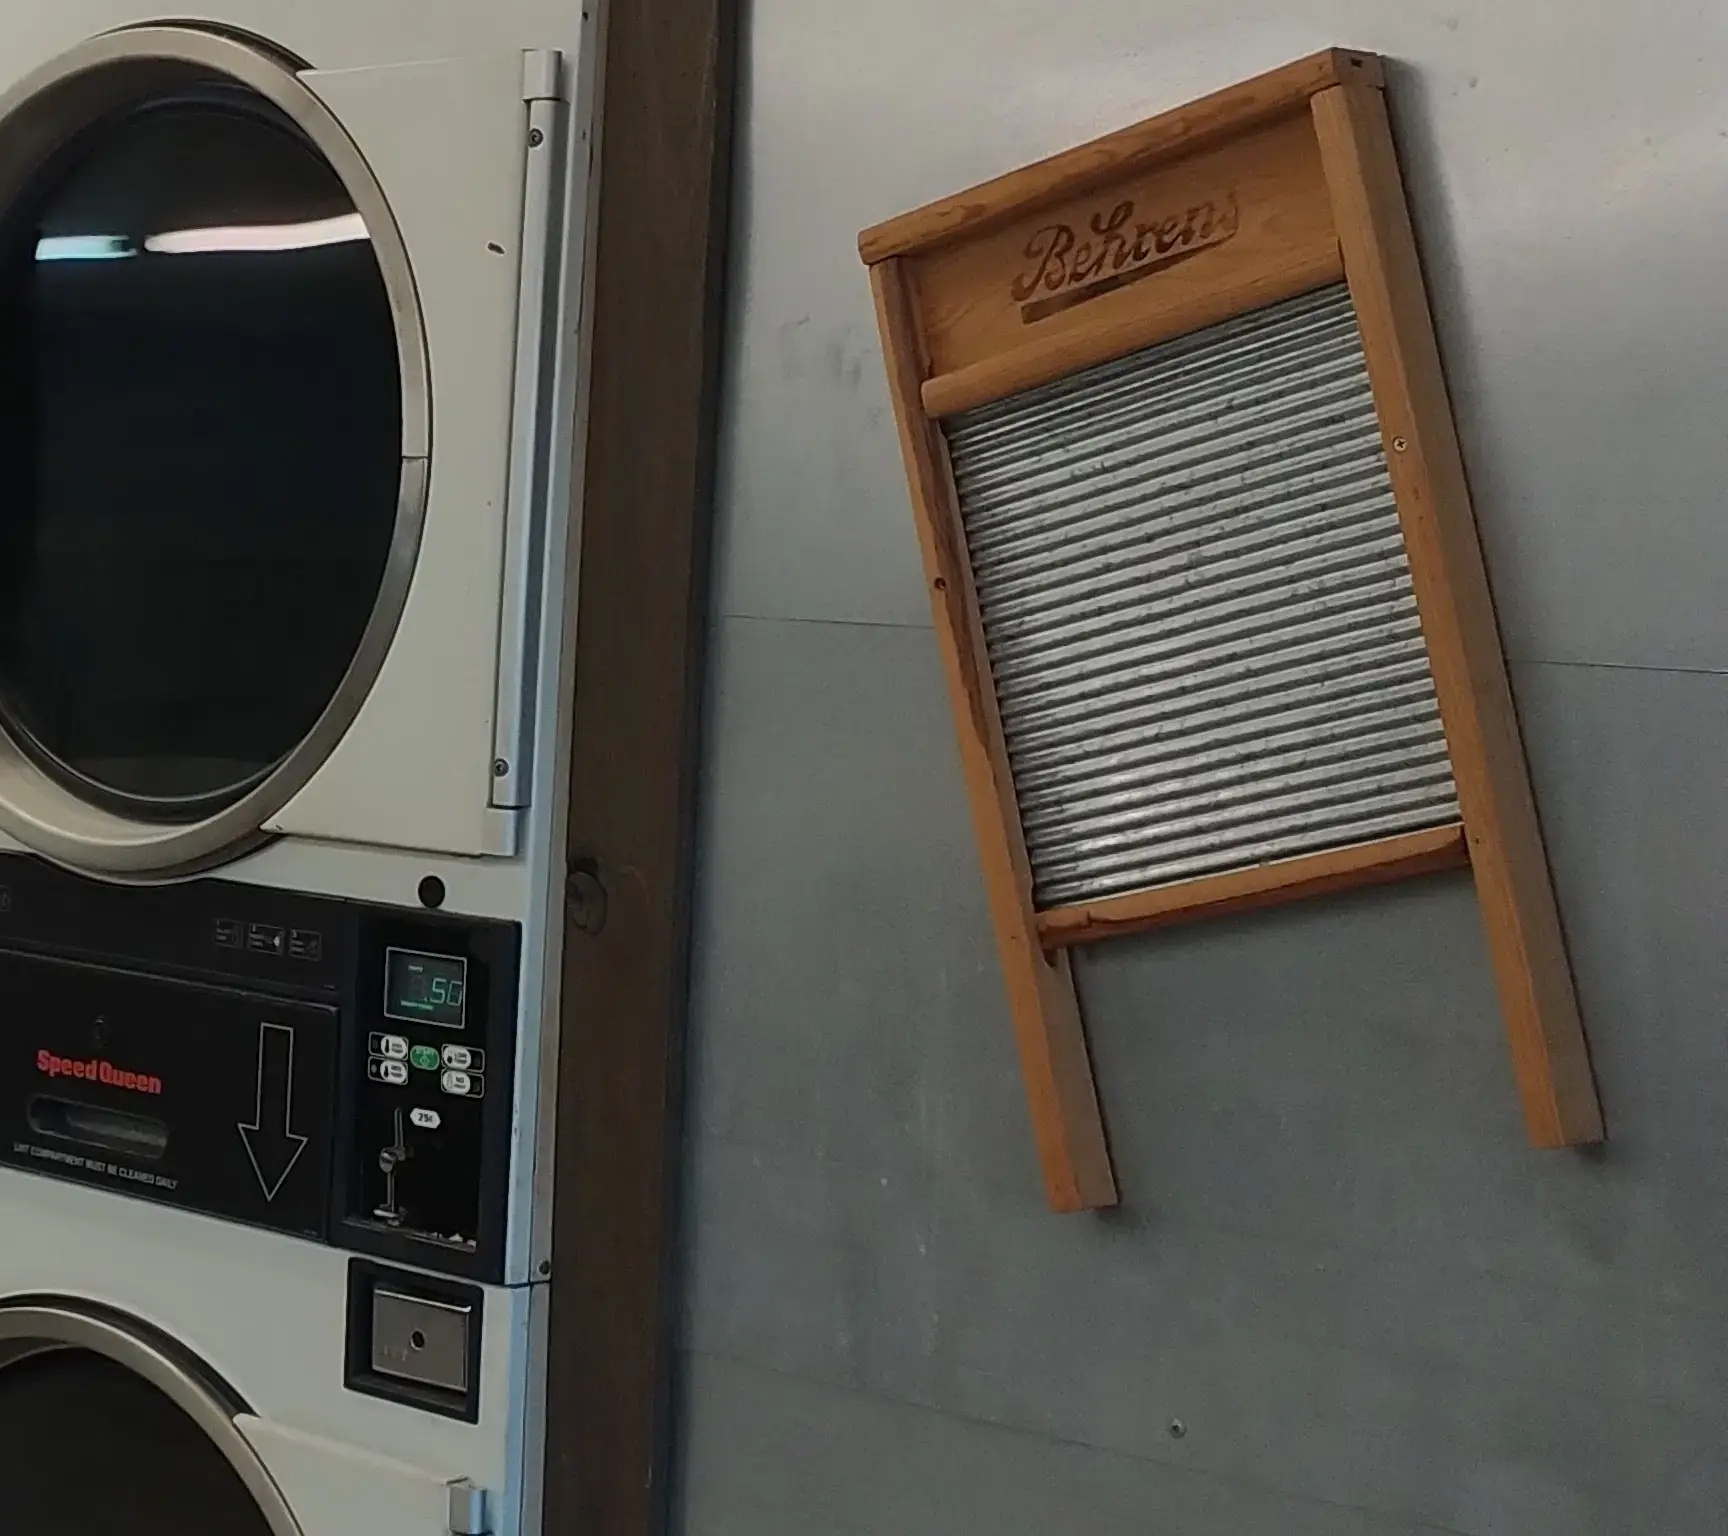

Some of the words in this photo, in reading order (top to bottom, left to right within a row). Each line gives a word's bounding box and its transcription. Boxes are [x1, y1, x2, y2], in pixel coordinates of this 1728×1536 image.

[1010, 192, 1240, 304] Behrens
[36, 1048, 98, 1079] Speed
[98, 1061, 163, 1095] Queen
